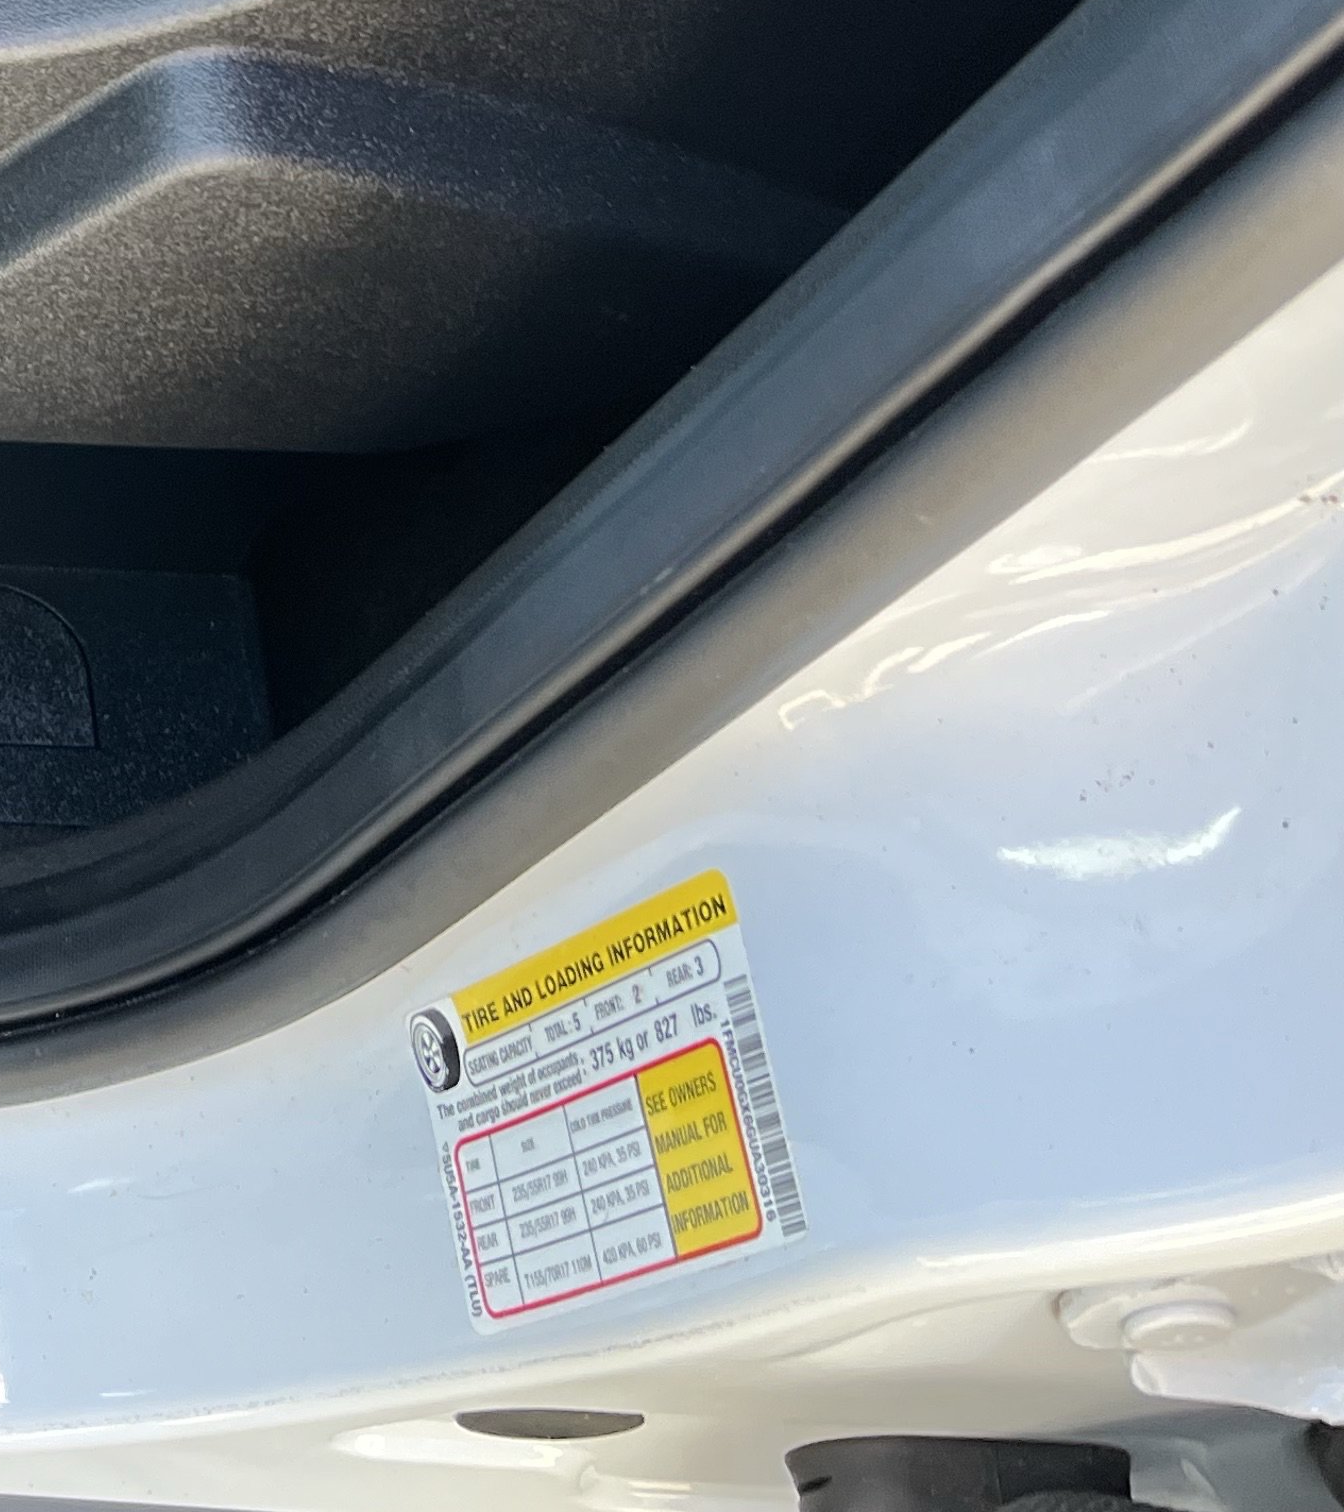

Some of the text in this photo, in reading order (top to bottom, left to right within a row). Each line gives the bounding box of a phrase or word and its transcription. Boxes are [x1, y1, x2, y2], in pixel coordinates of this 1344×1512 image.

[463, 892, 727, 1034] TIRE AND LOADING INFORMATION
[693, 956, 705, 976] 3
[631, 985, 642, 1004] 2
[572, 1012, 581, 1030] 5
[588, 997, 717, 1071] 375 kg or 827 lbs.
[468, 1034, 533, 1076] SEATING CAPACITY
[437, 1100, 455, 1120] The
[455, 1084, 499, 1115] combined
[498, 1073, 528, 1102] weight
[526, 1069, 537, 1086] of
[457, 1113, 475, 1132] and
[475, 1103, 502, 1128] cargo
[500, 1090, 529, 1116] should
[528, 1083, 552, 1104] never
[644, 1069, 717, 1117] SEE OWNERS
[654, 1109, 727, 1156] MANUAL FOR
[663, 1150, 734, 1194] ADDITIONAL
[670, 1189, 750, 1235] INFORMATION
[475, 1230, 498, 1252] REAR
[465, 1273, 483, 1318] (TLU)
[483, 1266, 511, 1290] SPARE
